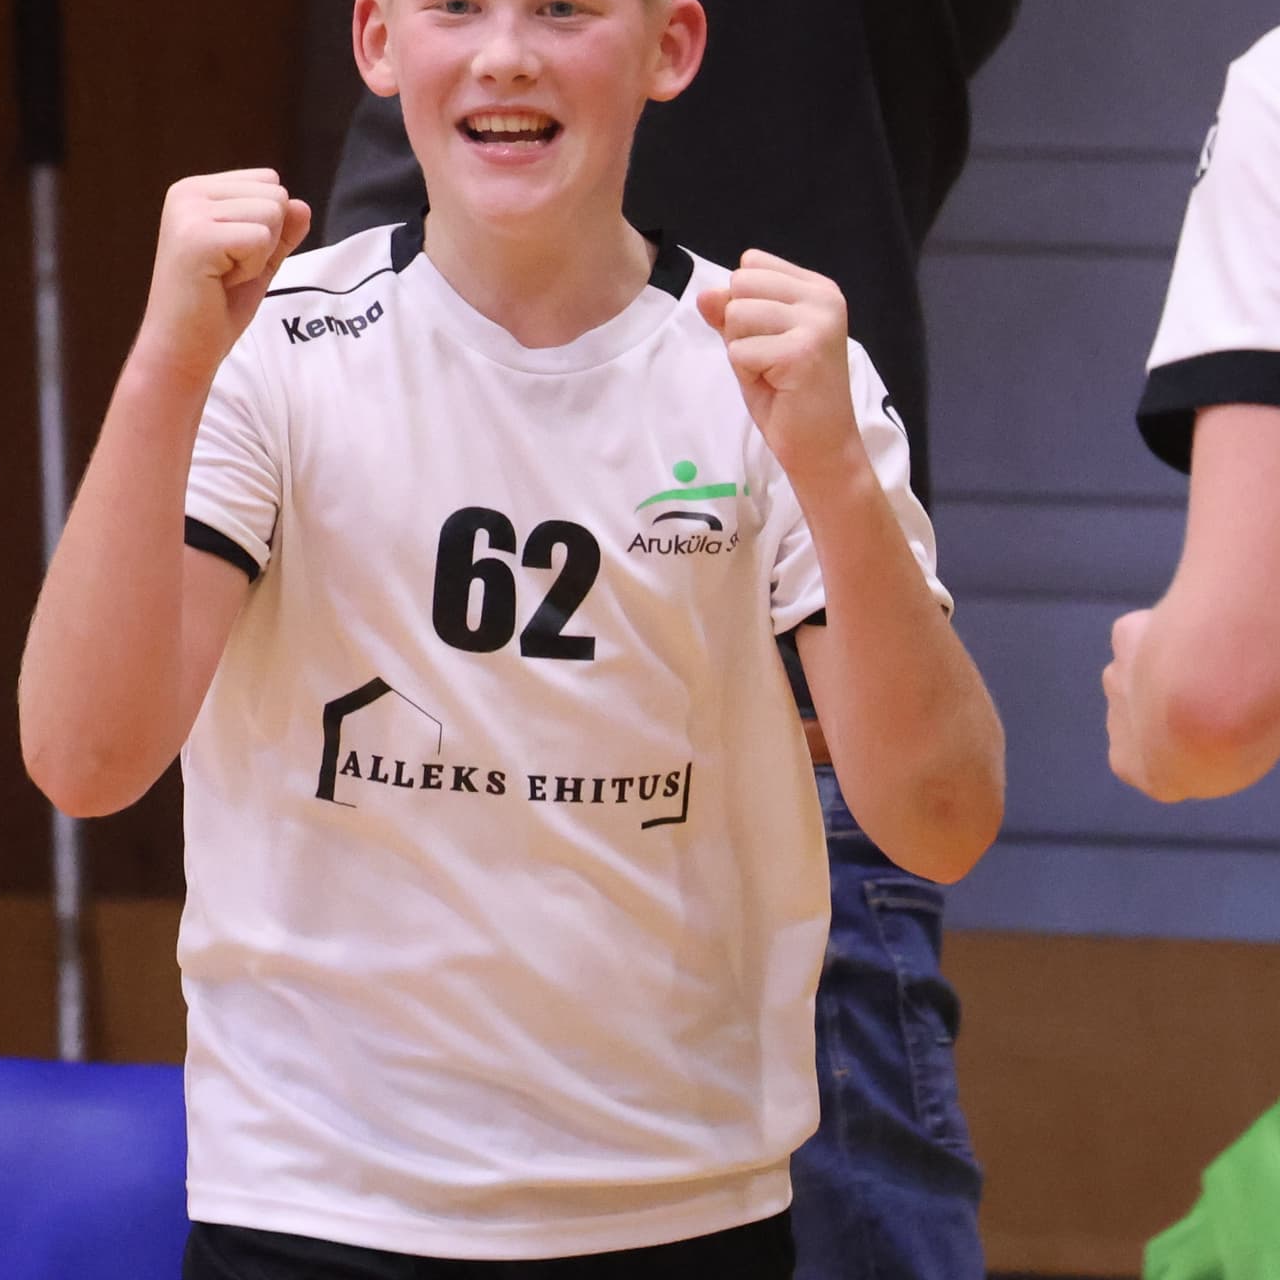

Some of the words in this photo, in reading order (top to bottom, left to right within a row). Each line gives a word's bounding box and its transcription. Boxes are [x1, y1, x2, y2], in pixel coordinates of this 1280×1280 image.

[281, 300, 384, 344] Kempa
[627, 533, 722, 555] Aruküla
[432, 506, 601, 661] 62
[339, 750, 507, 796] ALLEKS
[527, 770, 681, 804] EHITUS
